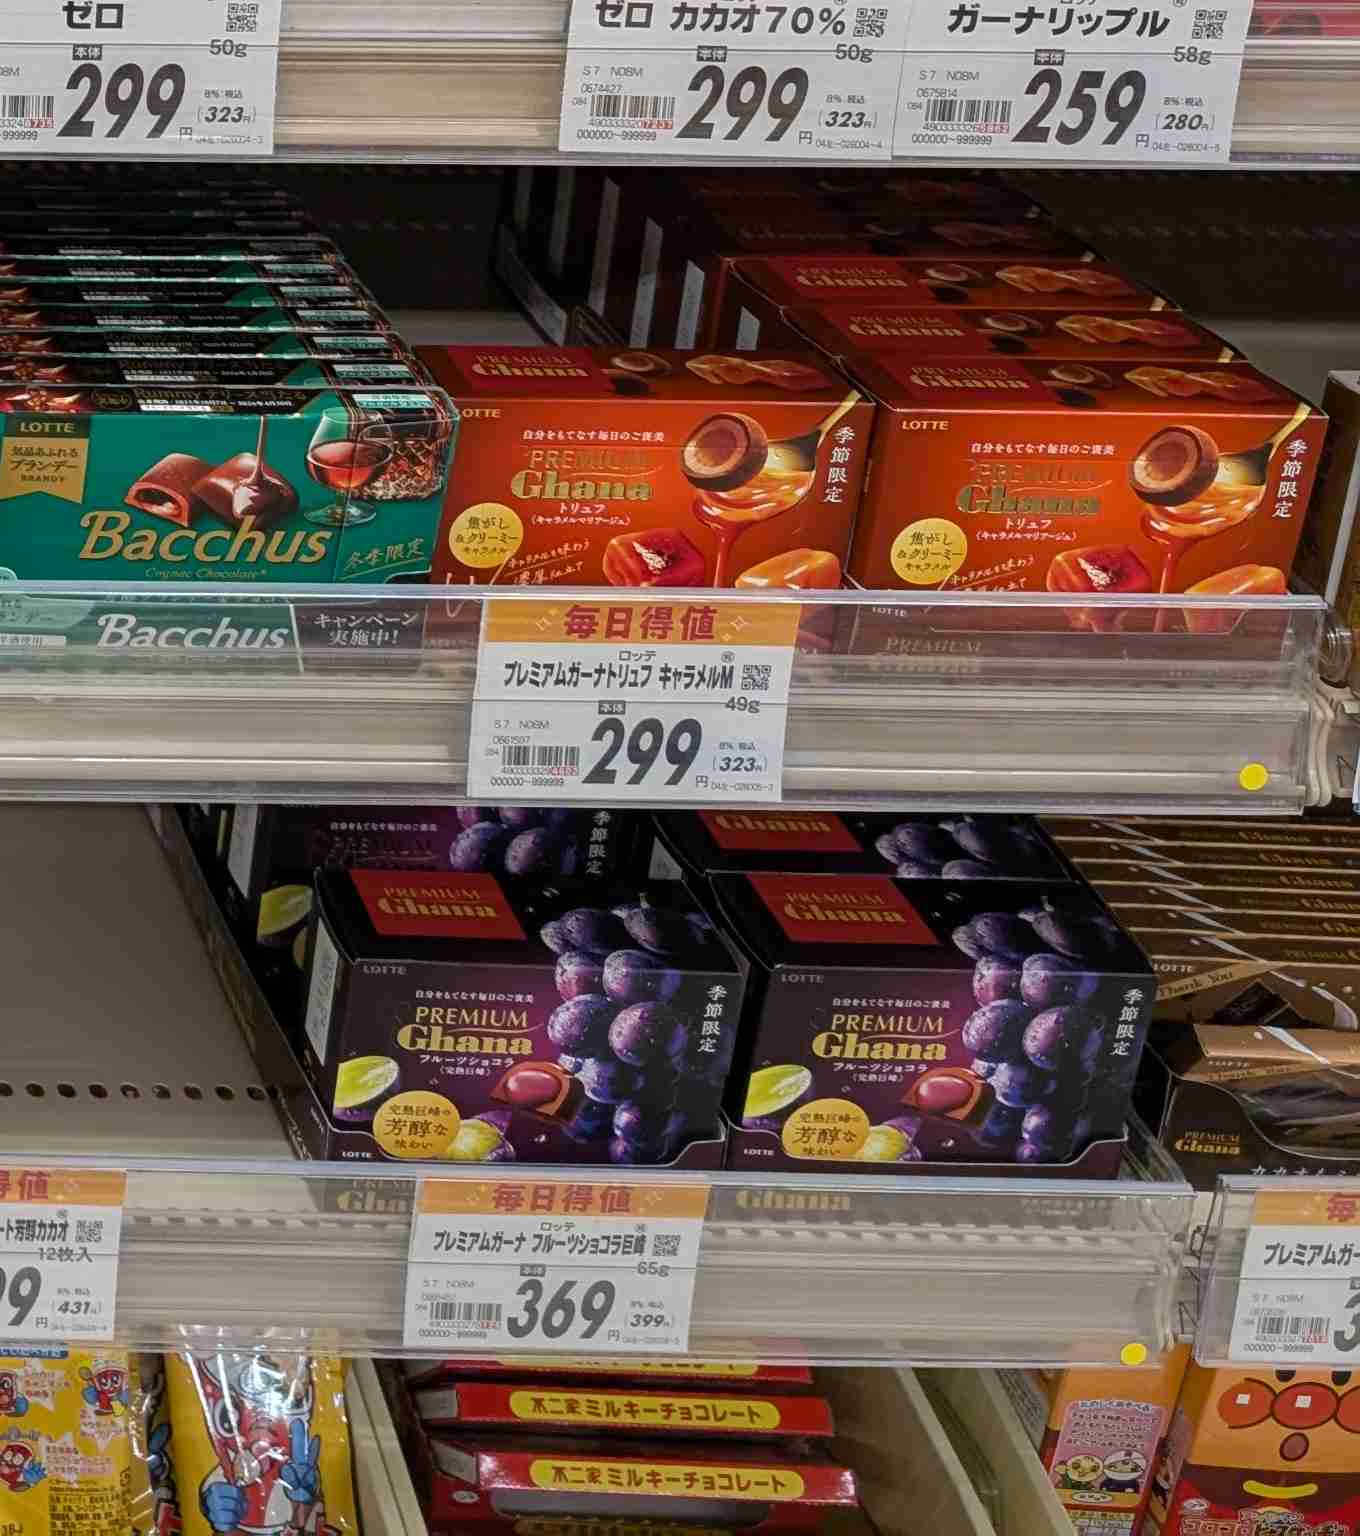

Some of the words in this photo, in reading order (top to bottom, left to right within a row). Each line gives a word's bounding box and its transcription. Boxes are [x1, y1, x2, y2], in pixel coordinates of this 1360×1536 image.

[61, 1, 125, 31] ゼロ
[593, 2, 653, 30] ゼロ
[669, 4, 847, 37] カカオ70%
[947, 4, 1171, 38] ガーナリップル
[208, 39, 248, 58] 50g
[834, 44, 874, 64] 50g
[1173, 45, 1212, 65] 58g
[56, 62, 186, 139] 299
[675, 65, 810, 140] 299
[1011, 69, 1148, 145] 259
[901, 420, 949, 431] LOTTE
[823, 426, 856, 504] 季節限定
[97, 613, 289, 650] Bacchus
[314, 612, 417, 628] キャンペーン
[563, 604, 718, 641] 毎日得値
[503, 662, 652, 690] プレミアムガーナトリュフ
[658, 662, 733, 690] キャラメルM
[724, 696, 760, 714] 49g
[581, 717, 703, 786] 299
[415, 1006, 529, 1027] PREMIUM
[831, 1014, 944, 1034] PREMIUM
[397, 1024, 533, 1055] Ghana
[811, 1032, 948, 1061] Ghana
[791, 1124, 857, 1146] 芳醇な
[38, 1247, 93, 1263] 12枚入
[434, 1230, 526, 1253] プレミアムガーナ
[532, 1232, 646, 1256] フルーツショコラ巨峰
[506, 1278, 616, 1339] 369
[584, 1400, 761, 1424] ミルキーチョコレート
